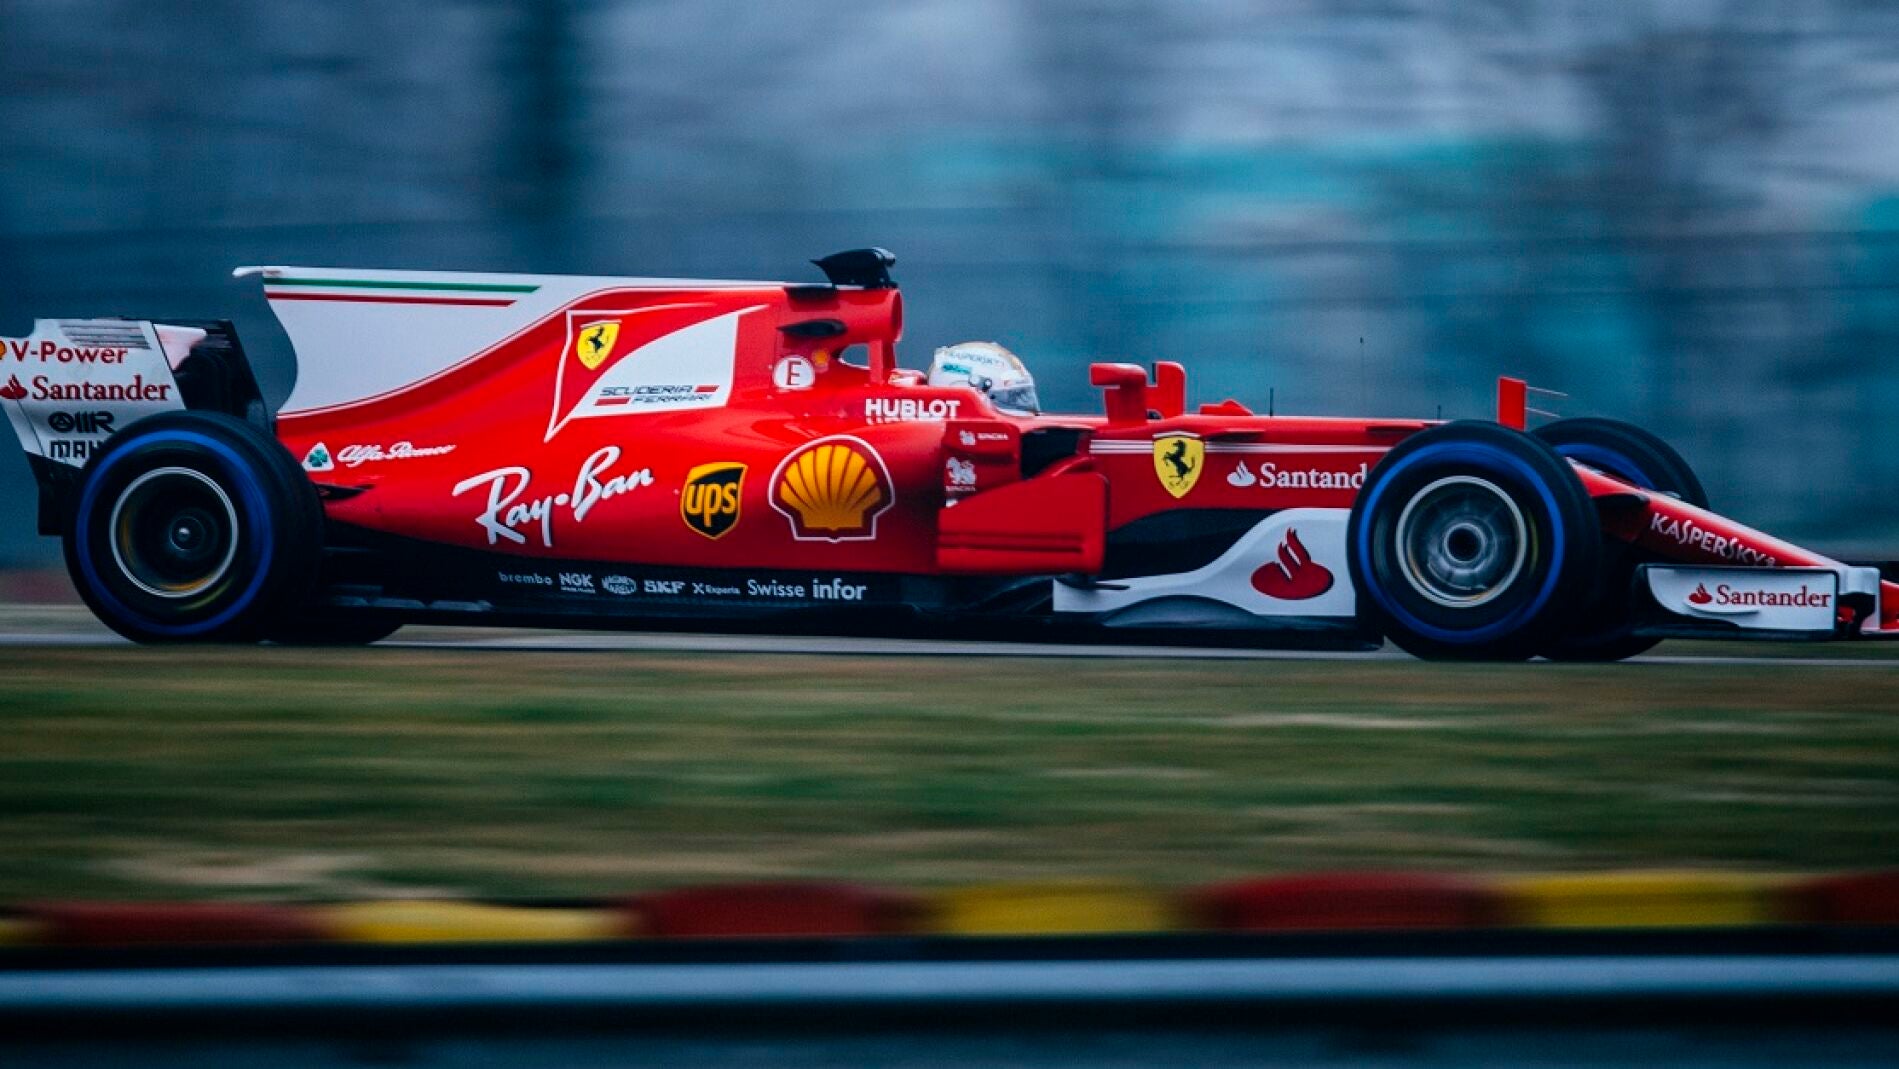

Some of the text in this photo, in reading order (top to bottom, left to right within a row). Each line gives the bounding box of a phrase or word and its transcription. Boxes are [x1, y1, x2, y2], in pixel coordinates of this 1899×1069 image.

[11, 340, 128, 364] V-Power
[787, 360, 801, 386] E
[32, 375, 171, 401] Santander
[600, 385, 693, 396] SCUDERIA
[865, 399, 960, 418] HUBLOT
[498, 571, 553, 585] brembo
[559, 573, 594, 587] NGK
[643, 580, 685, 593] SKF
[747, 579, 805, 597] Swisse
[812, 577, 866, 600] infor
[1716, 584, 1831, 608] Santander
